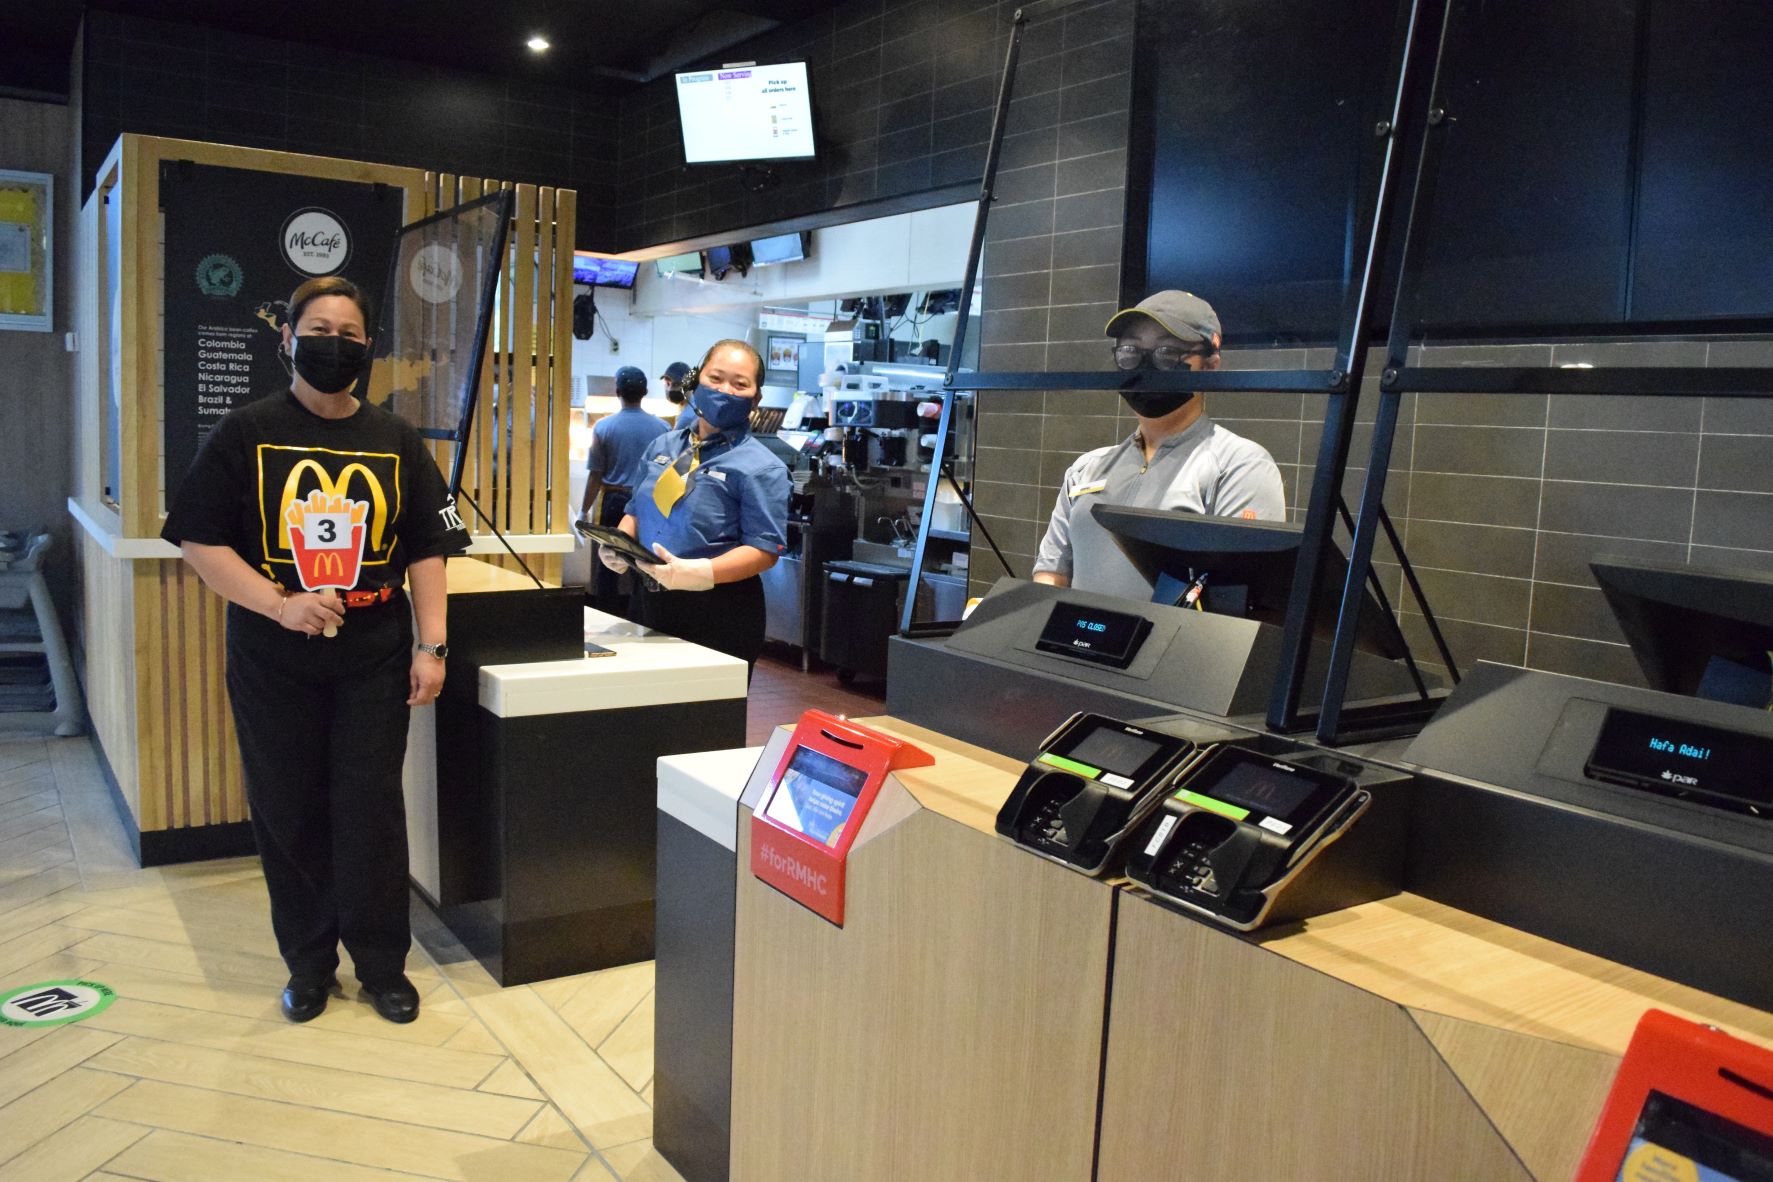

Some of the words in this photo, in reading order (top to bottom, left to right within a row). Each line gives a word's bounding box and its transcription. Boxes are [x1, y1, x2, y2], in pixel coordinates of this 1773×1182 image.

[289, 231, 341, 252] McCafé
[198, 338, 246, 349] Colombia
[198, 350, 253, 361] Guatemala
[198, 362, 226, 371] Costa
[228, 362, 250, 372] Rica
[198, 373, 250, 384] Nicaragua
[198, 384, 206, 392] El
[208, 384, 250, 394] Salvador
[198, 395, 224, 404] Brazil
[225, 396, 232, 405] &
[317, 519, 337, 543] 3
[1649, 738, 1675, 752] Hafa
[1679, 744, 1711, 760] Adai!
[760, 844, 828, 896] #forRMHC
